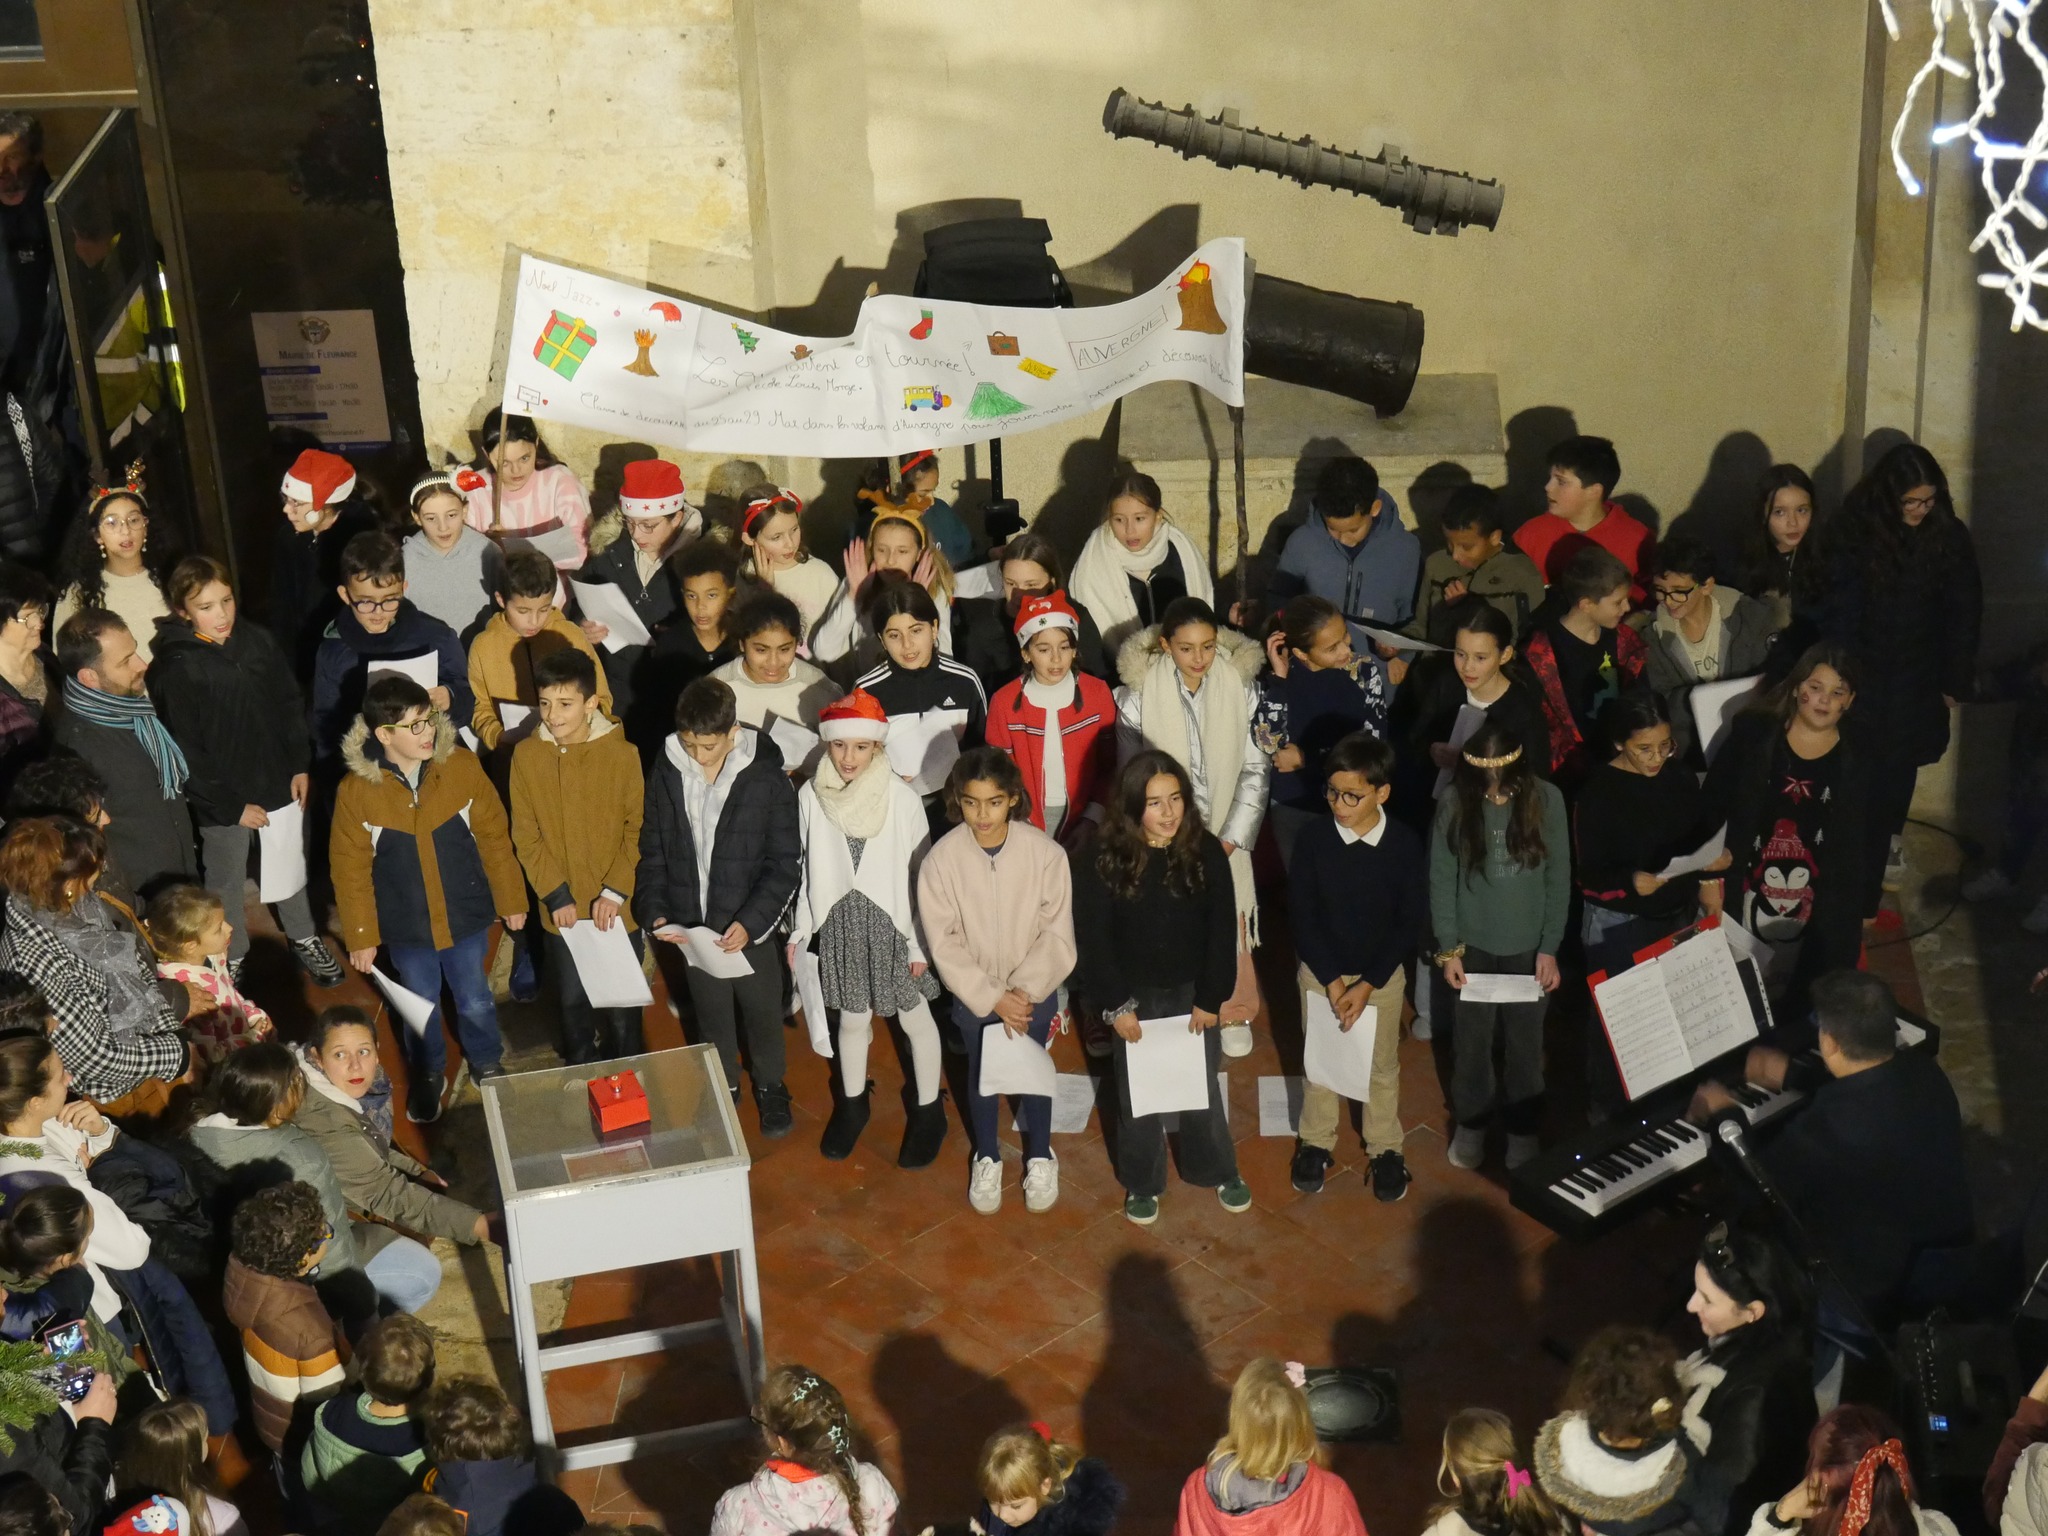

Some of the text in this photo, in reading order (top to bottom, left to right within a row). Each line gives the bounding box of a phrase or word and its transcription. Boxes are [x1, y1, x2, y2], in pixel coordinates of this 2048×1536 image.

[317, 349, 358, 358] FLEURANCE
[1078, 316, 1162, 367] AUVERGNE
[693, 354, 729, 388] Les
[885, 344, 963, 373] tournée
[1694, 652, 1719, 675] FOX
